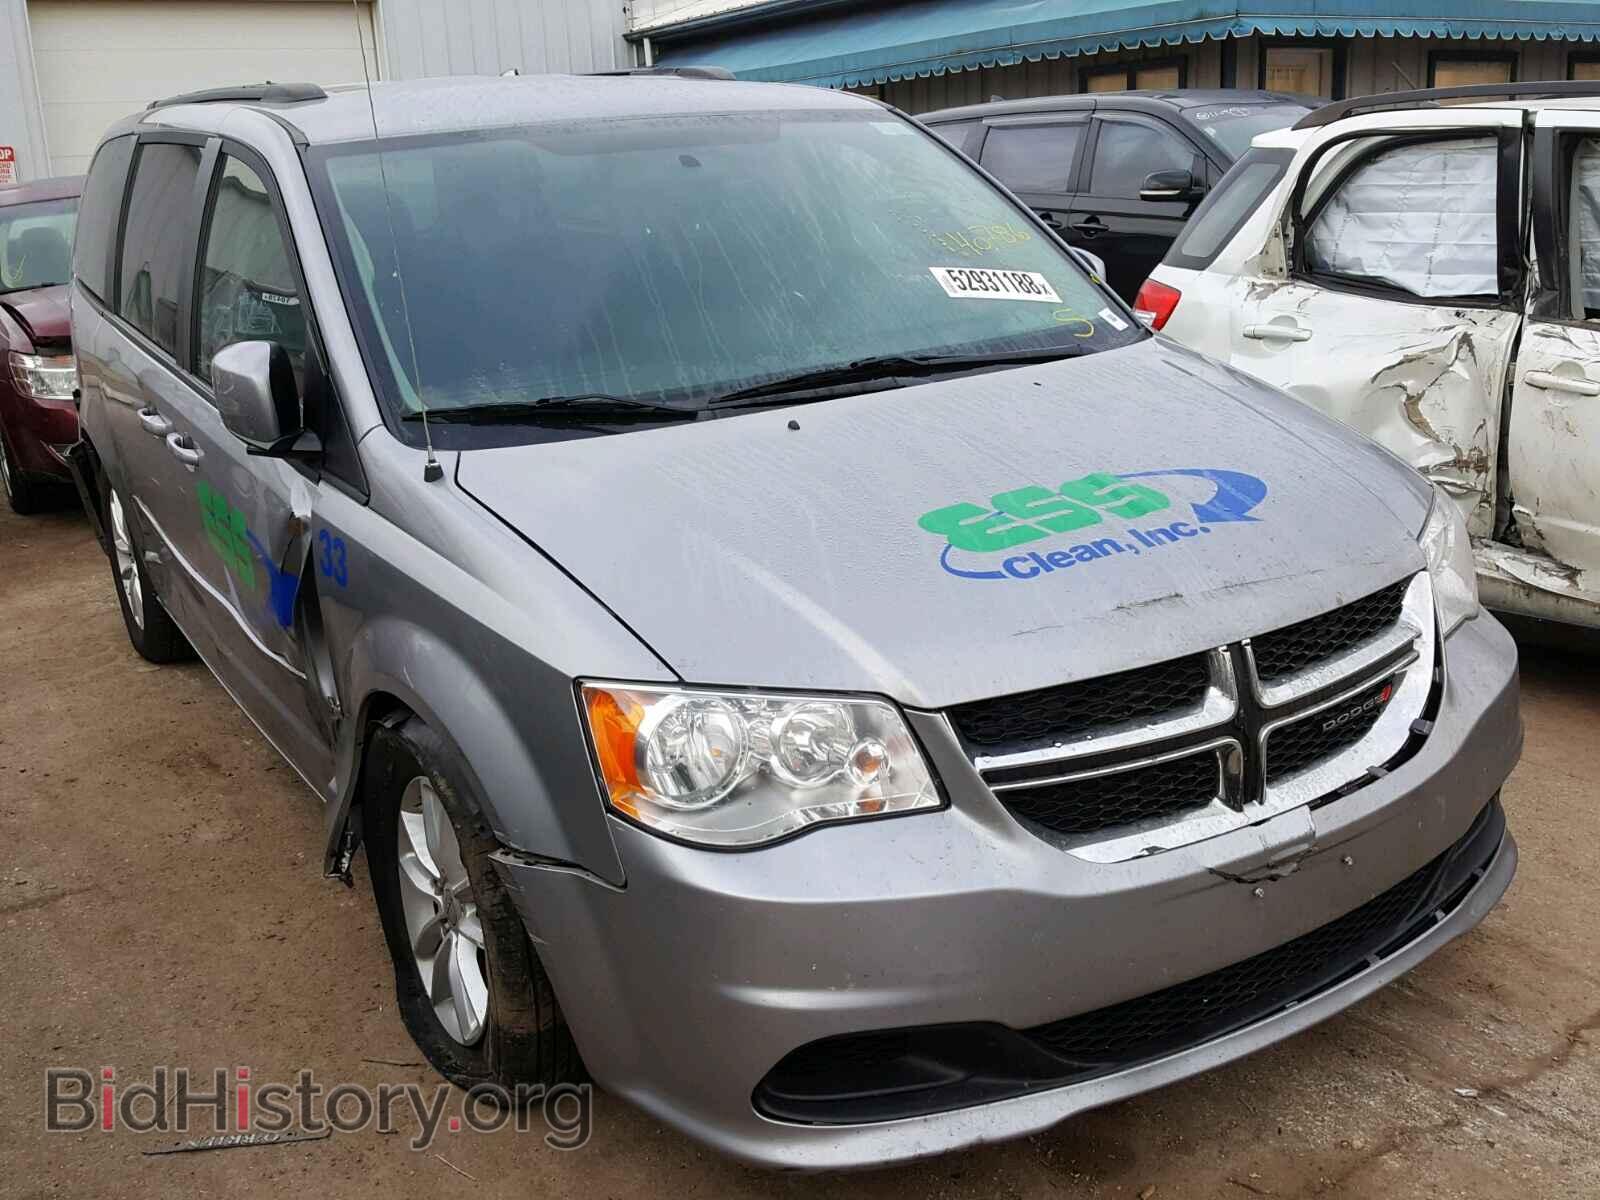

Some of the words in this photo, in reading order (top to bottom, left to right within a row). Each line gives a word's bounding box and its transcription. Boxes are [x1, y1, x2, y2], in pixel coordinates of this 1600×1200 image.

[319, 528, 349, 588] 33
[1001, 537, 1140, 580] Clean,
[1127, 521, 1211, 548] Inc.
[1322, 695, 1385, 733] DODGE
